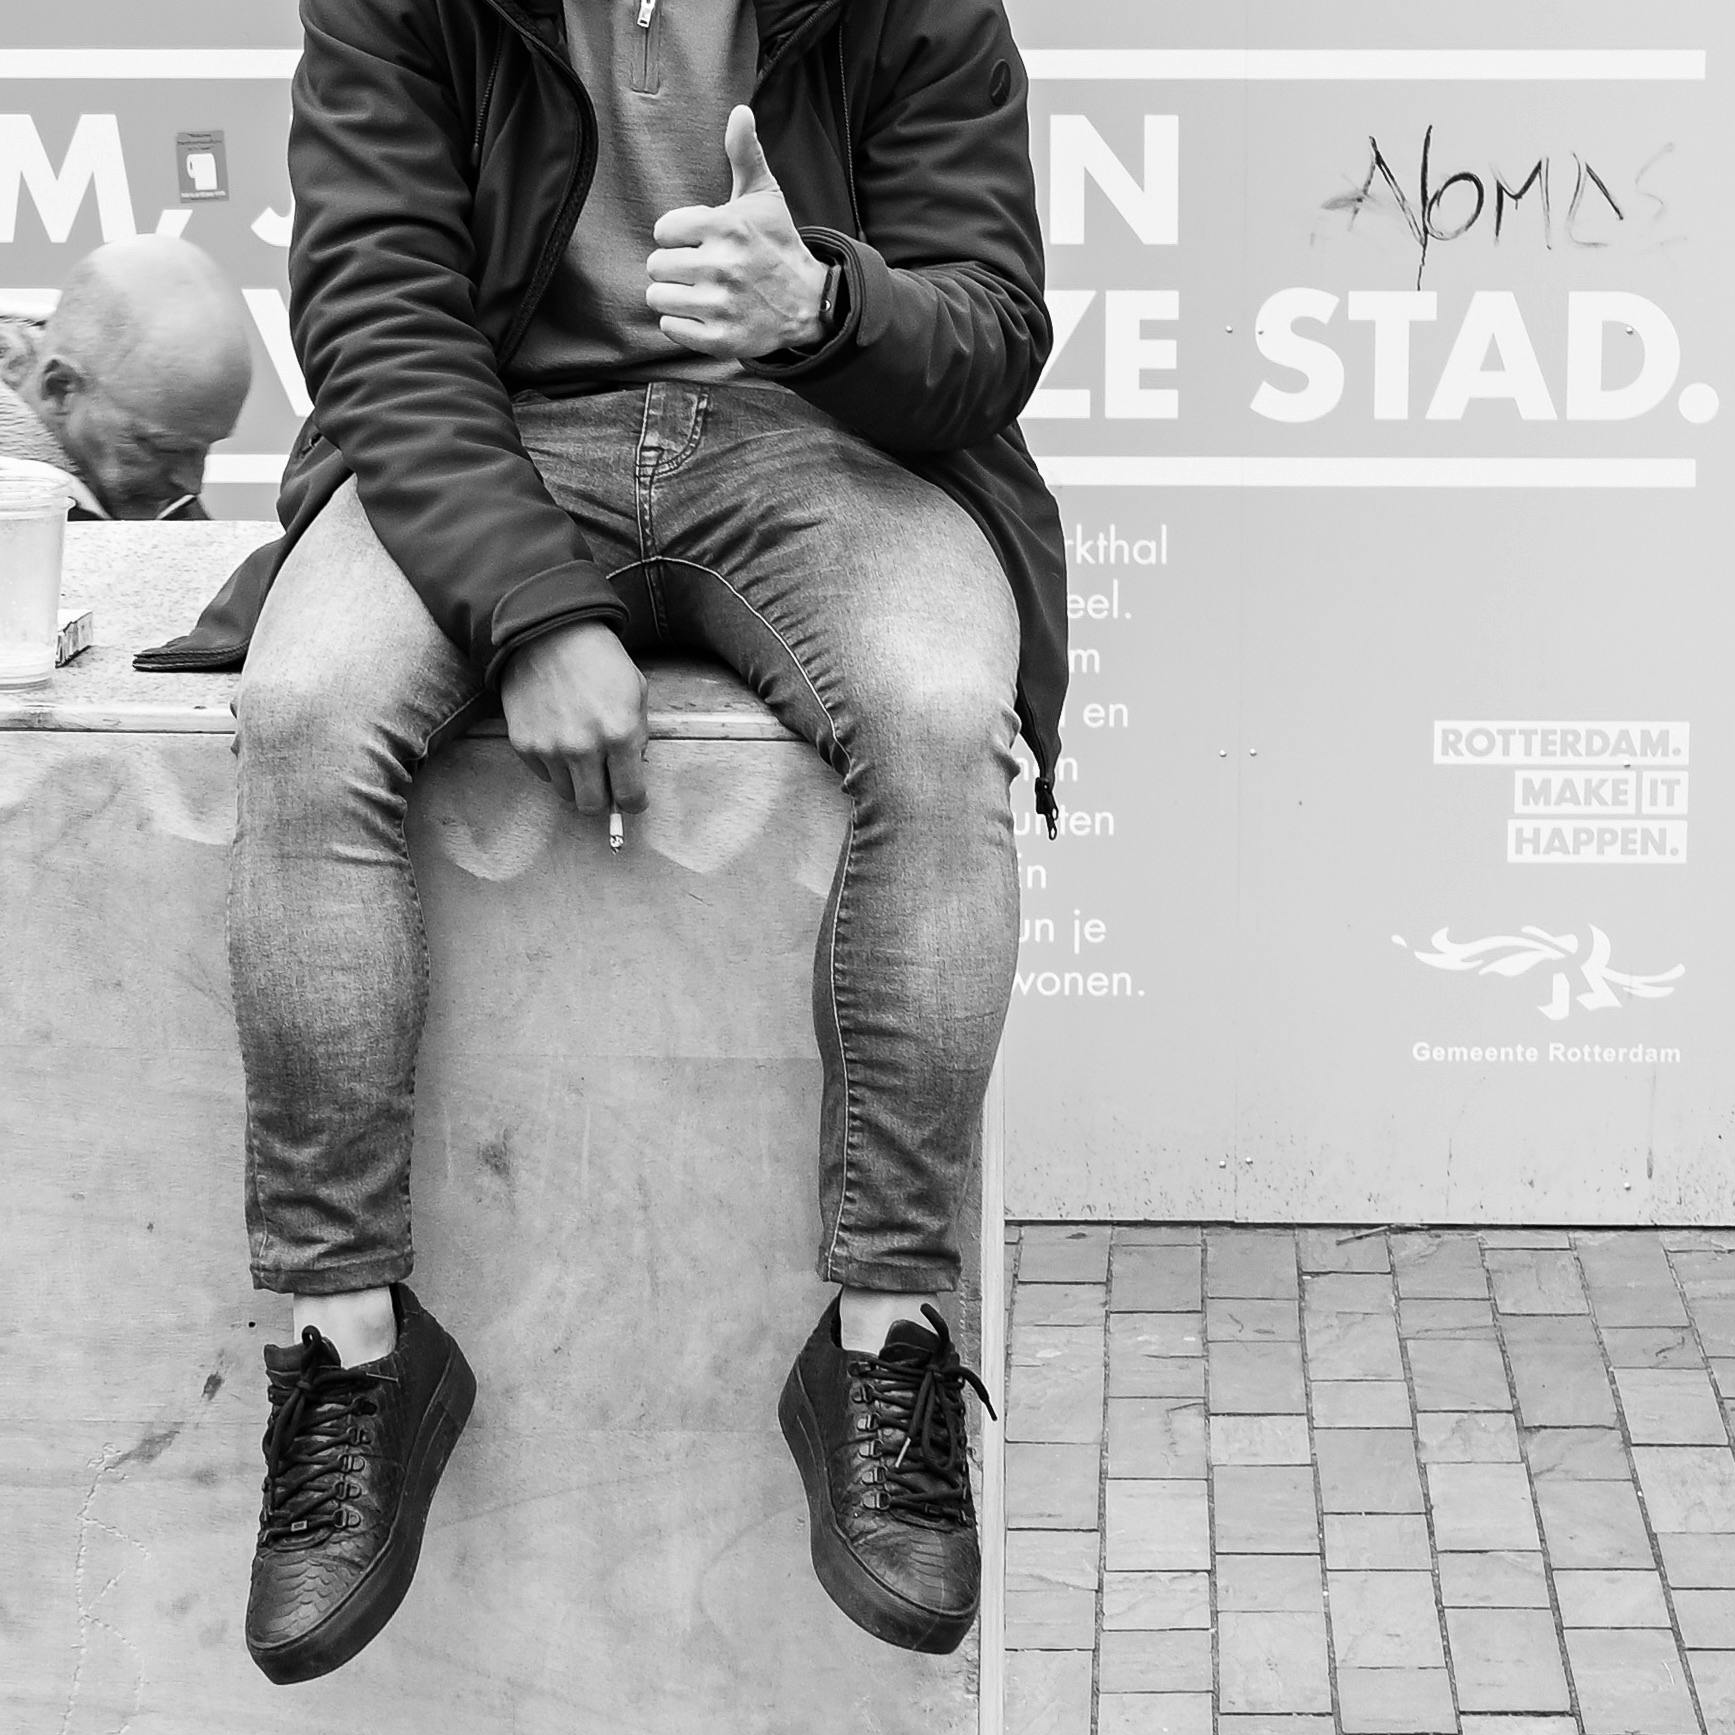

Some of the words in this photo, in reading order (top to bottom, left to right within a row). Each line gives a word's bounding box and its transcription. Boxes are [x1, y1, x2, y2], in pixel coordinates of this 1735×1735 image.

[1049, 114, 1179, 245] N
[1016, 289, 1180, 420] ZE
[1249, 286, 1720, 425] STAD.
[1066, 578, 1133, 620] eel.
[1082, 702, 1129, 729] en
[1439, 727, 1683, 758] ROTTERDAM.
[1520, 777, 1629, 807] MAKE
[1648, 778, 1681, 807] IT
[1014, 805, 1114, 836] unten
[1513, 826, 1680, 857] HAPPEN.
[1073, 909, 1107, 955] je
[1411, 1041, 1539, 1064] Gemeente
[1548, 1042, 1682, 1064] Rotterdam
